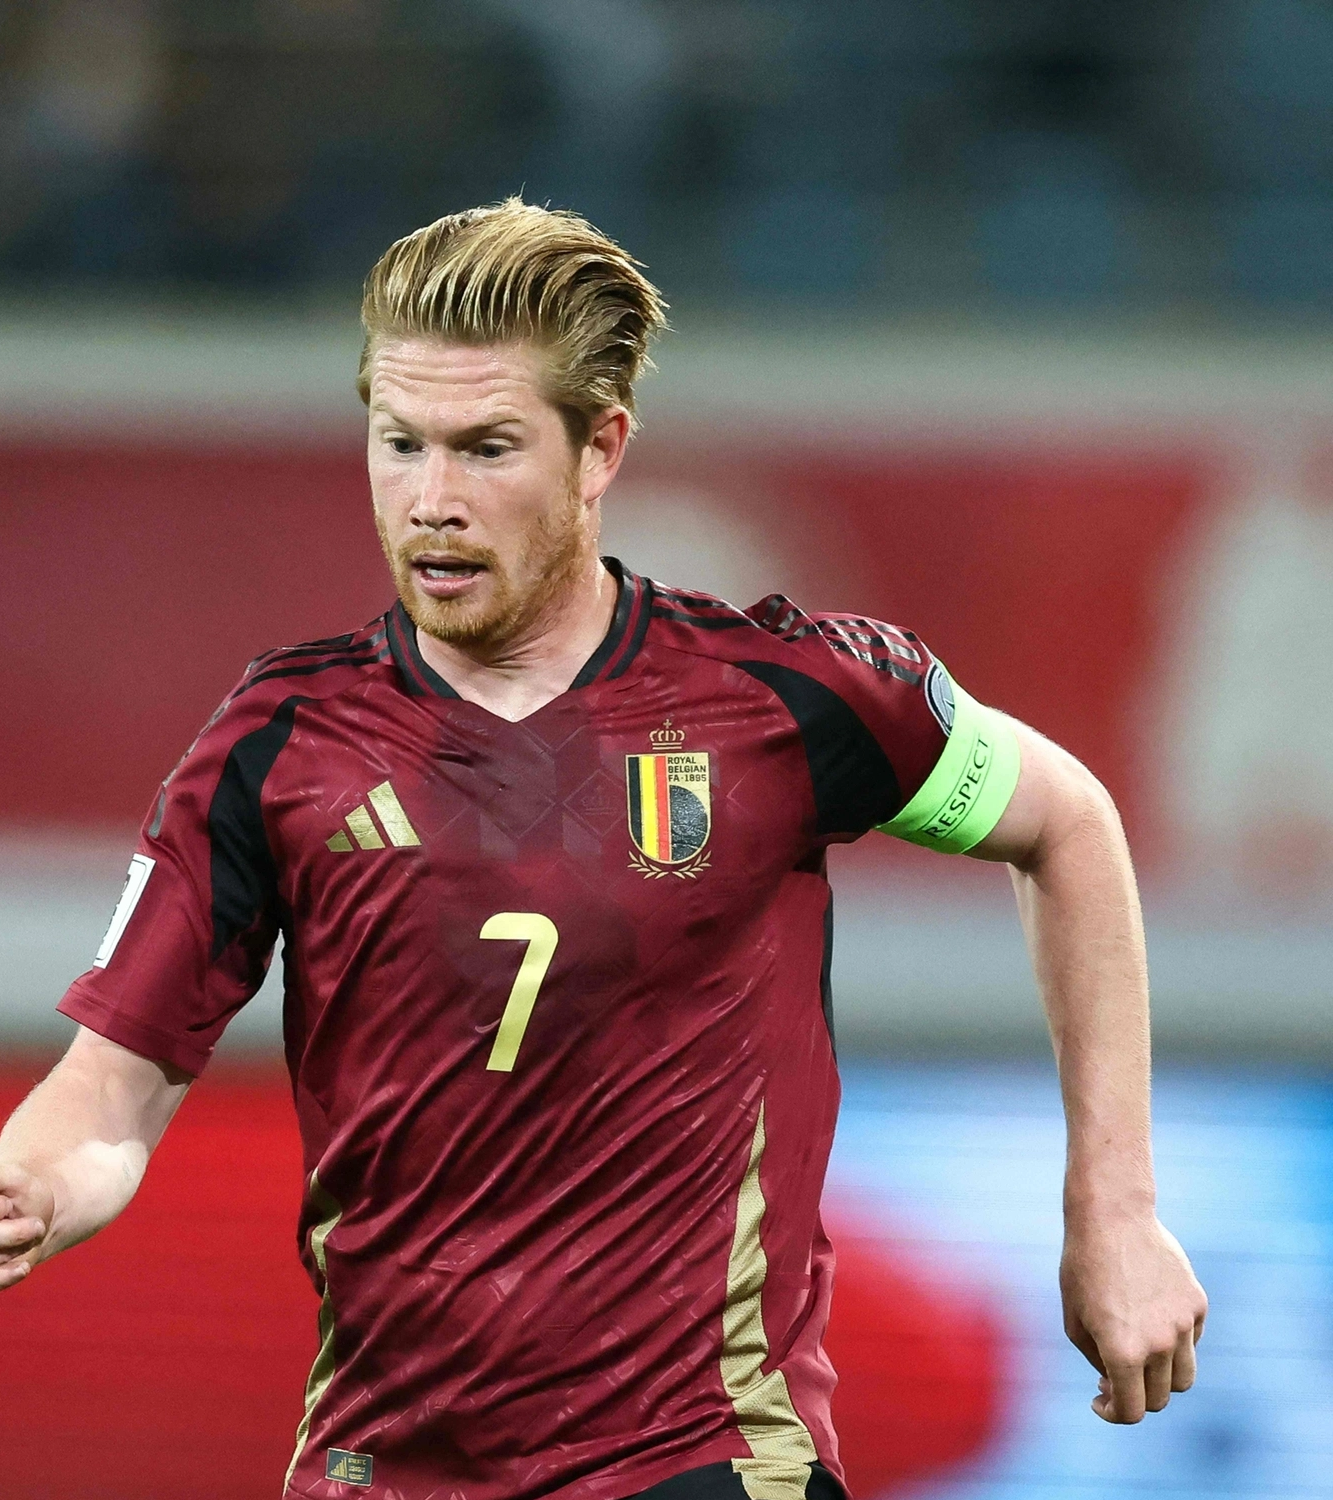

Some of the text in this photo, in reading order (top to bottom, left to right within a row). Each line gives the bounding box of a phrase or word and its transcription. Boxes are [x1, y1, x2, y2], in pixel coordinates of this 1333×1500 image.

[668, 756, 696, 764] ROYAL
[668, 765, 706, 773] BELGIAN
[924, 733, 989, 837] RESPECT
[479, 911, 559, 1072] 7
